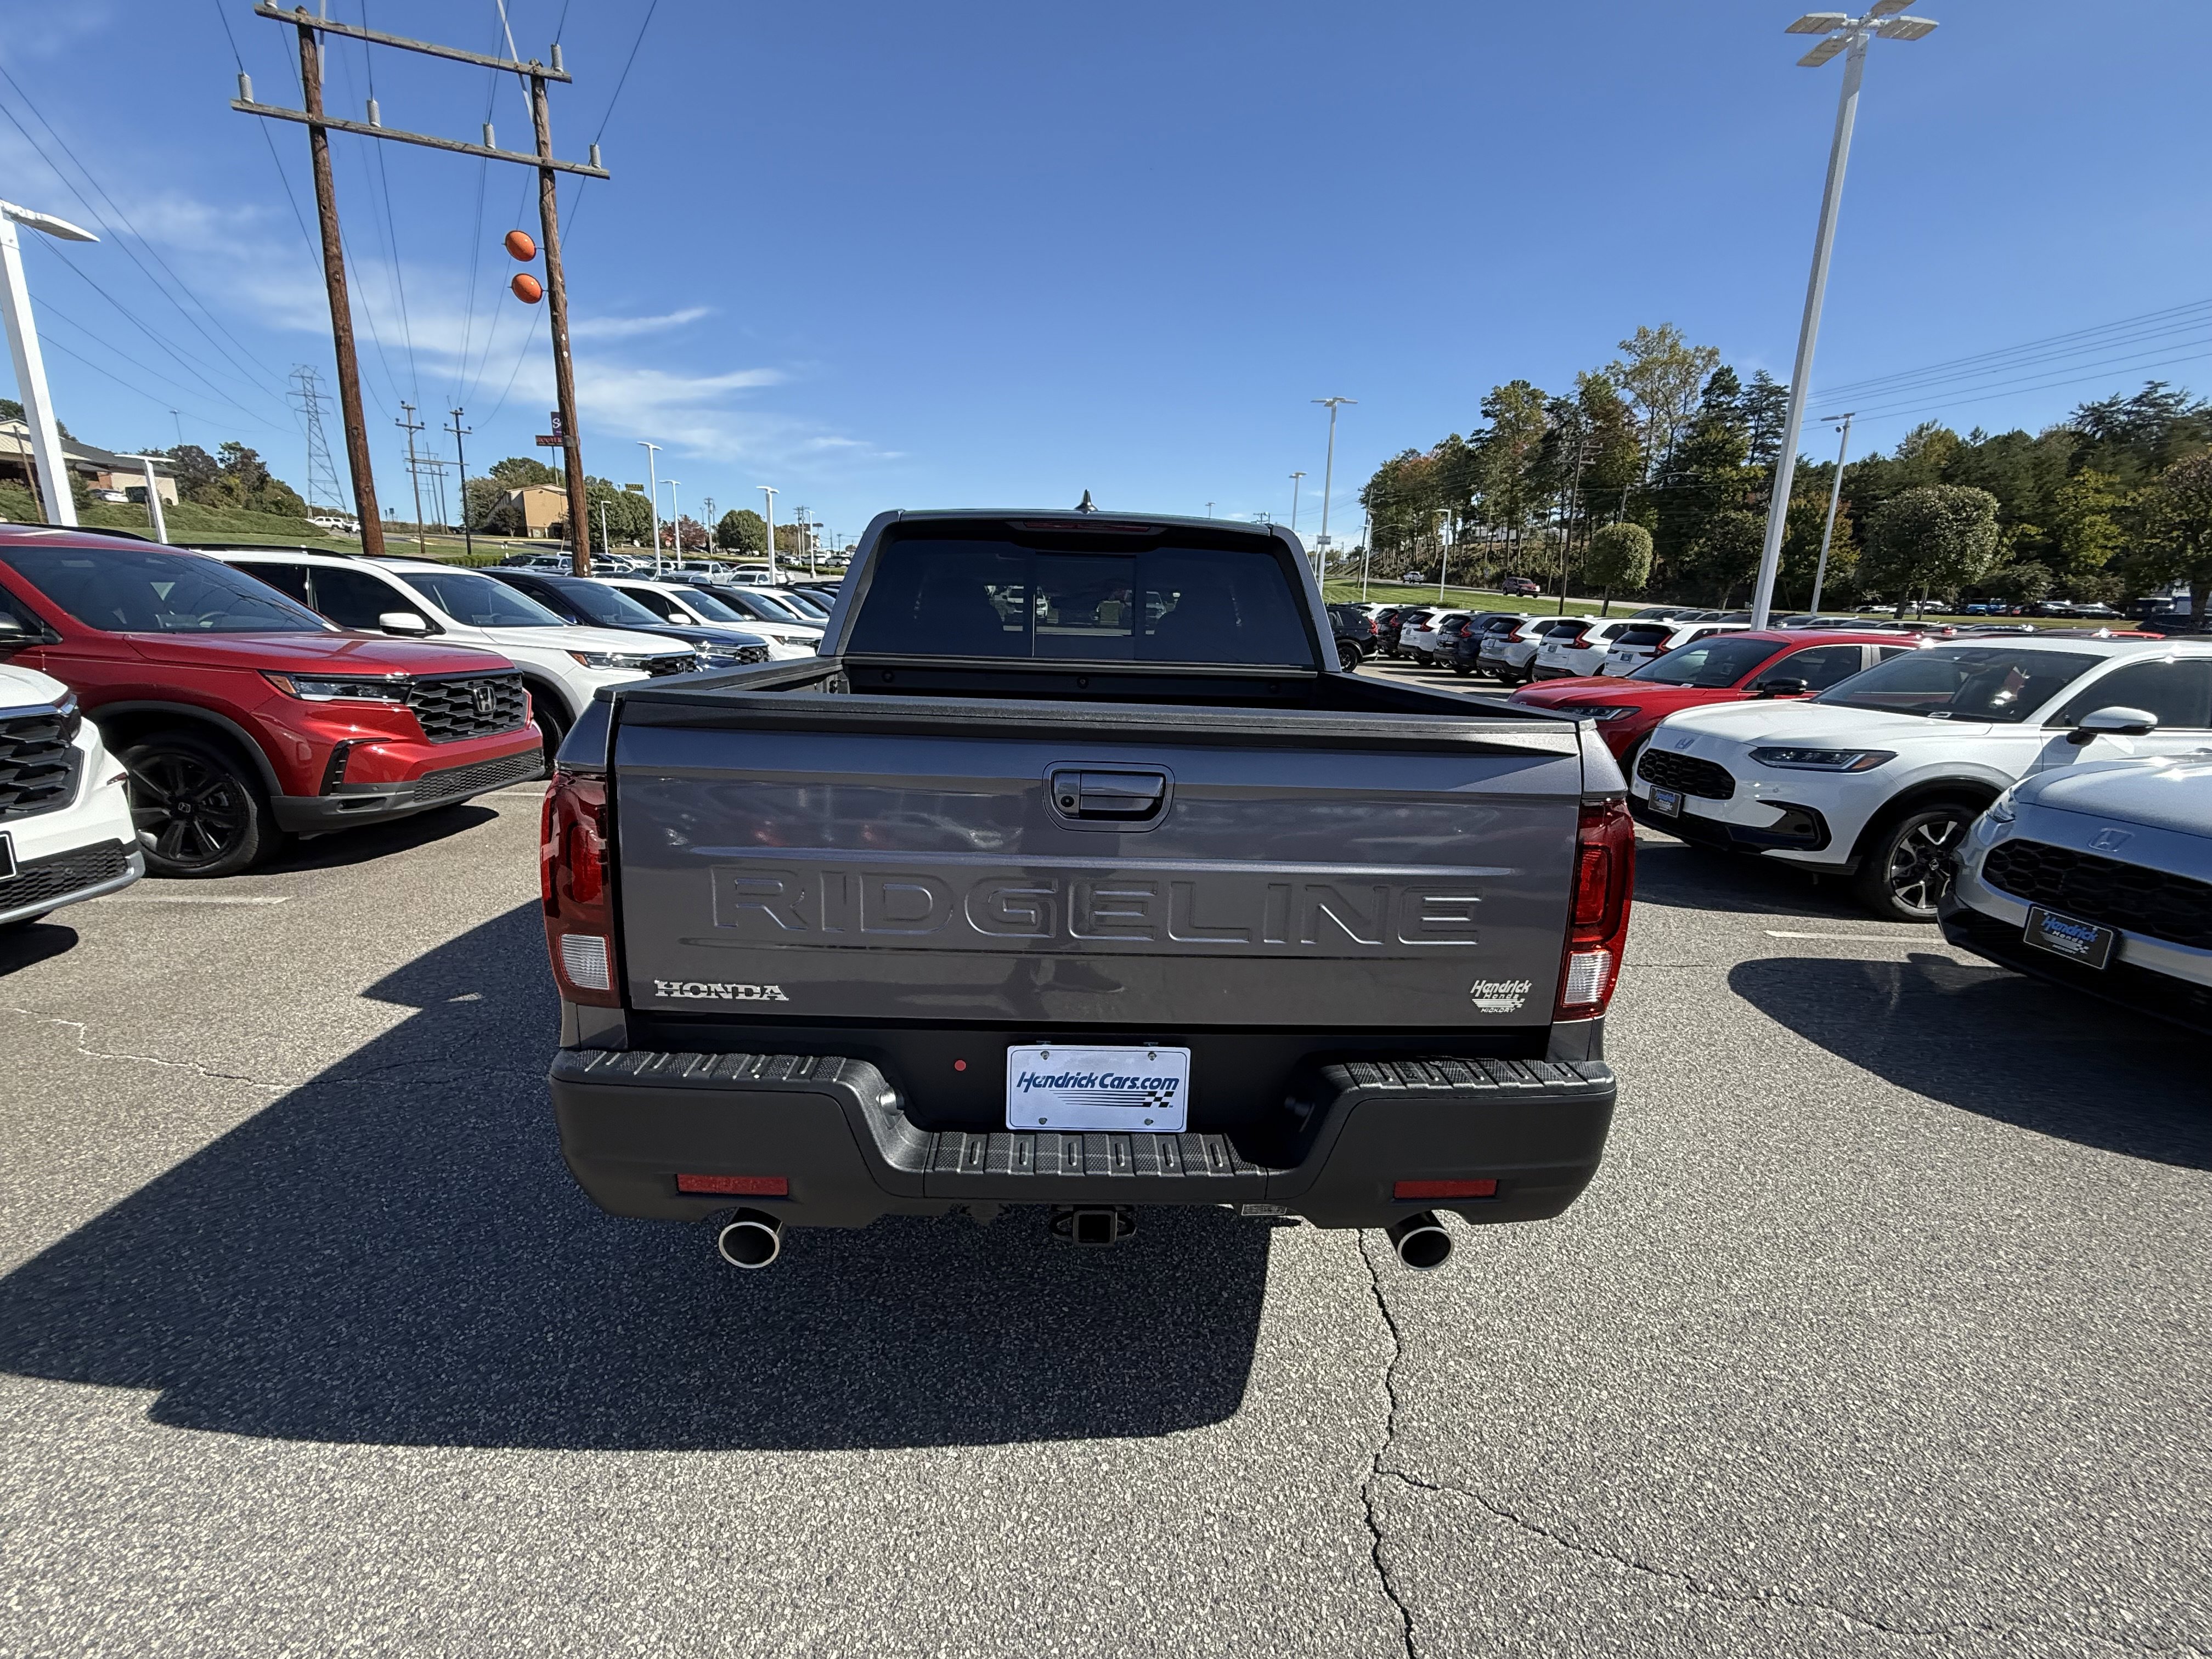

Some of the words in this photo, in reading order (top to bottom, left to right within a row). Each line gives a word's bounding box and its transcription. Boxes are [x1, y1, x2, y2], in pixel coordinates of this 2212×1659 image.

[711, 866, 1482, 946] RIDGELINE
[654, 980, 789, 1001] HONDA
[1470, 980, 1532, 997] Hendrick
